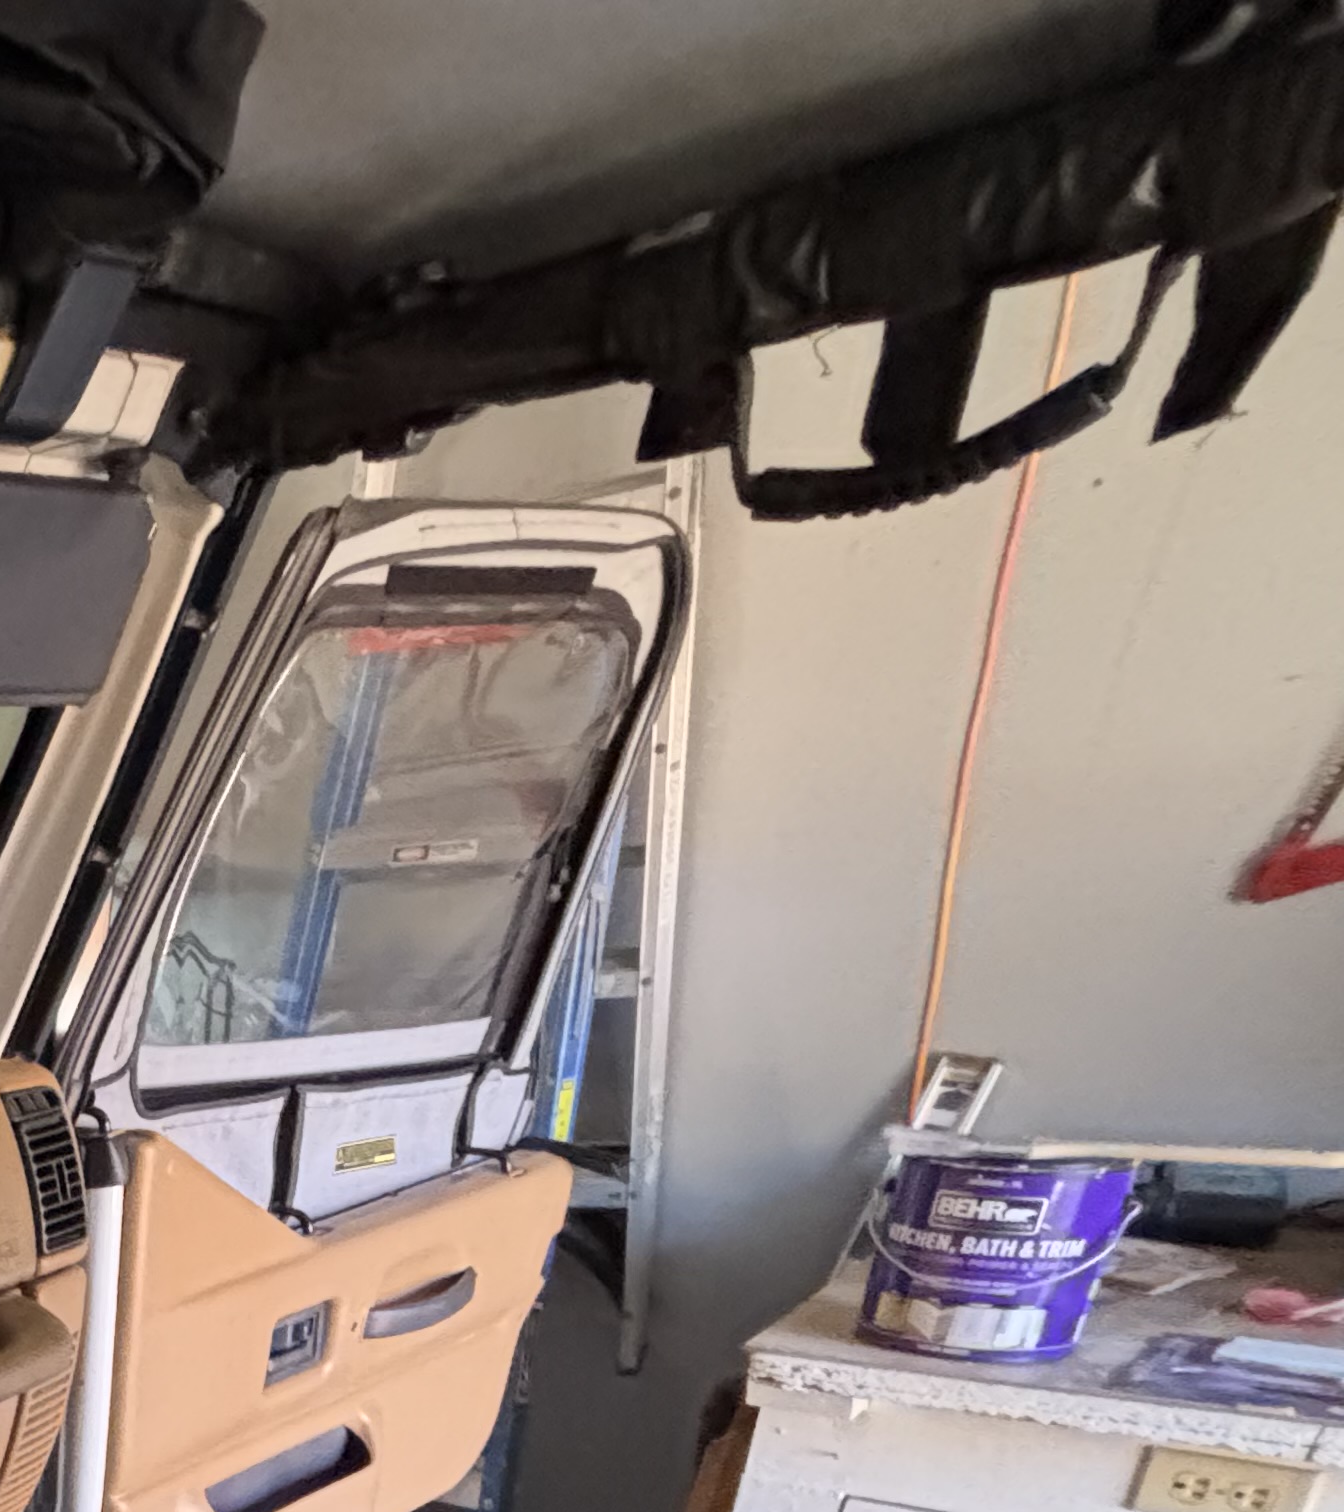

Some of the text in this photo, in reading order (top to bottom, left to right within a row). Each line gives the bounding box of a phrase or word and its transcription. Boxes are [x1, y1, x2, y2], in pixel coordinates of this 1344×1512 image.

[936, 1197, 1008, 1222] BEHR
[959, 1236, 1018, 1258] BATH
[1018, 1239, 1035, 1258] &
[1038, 1238, 1087, 1258] TRIM
